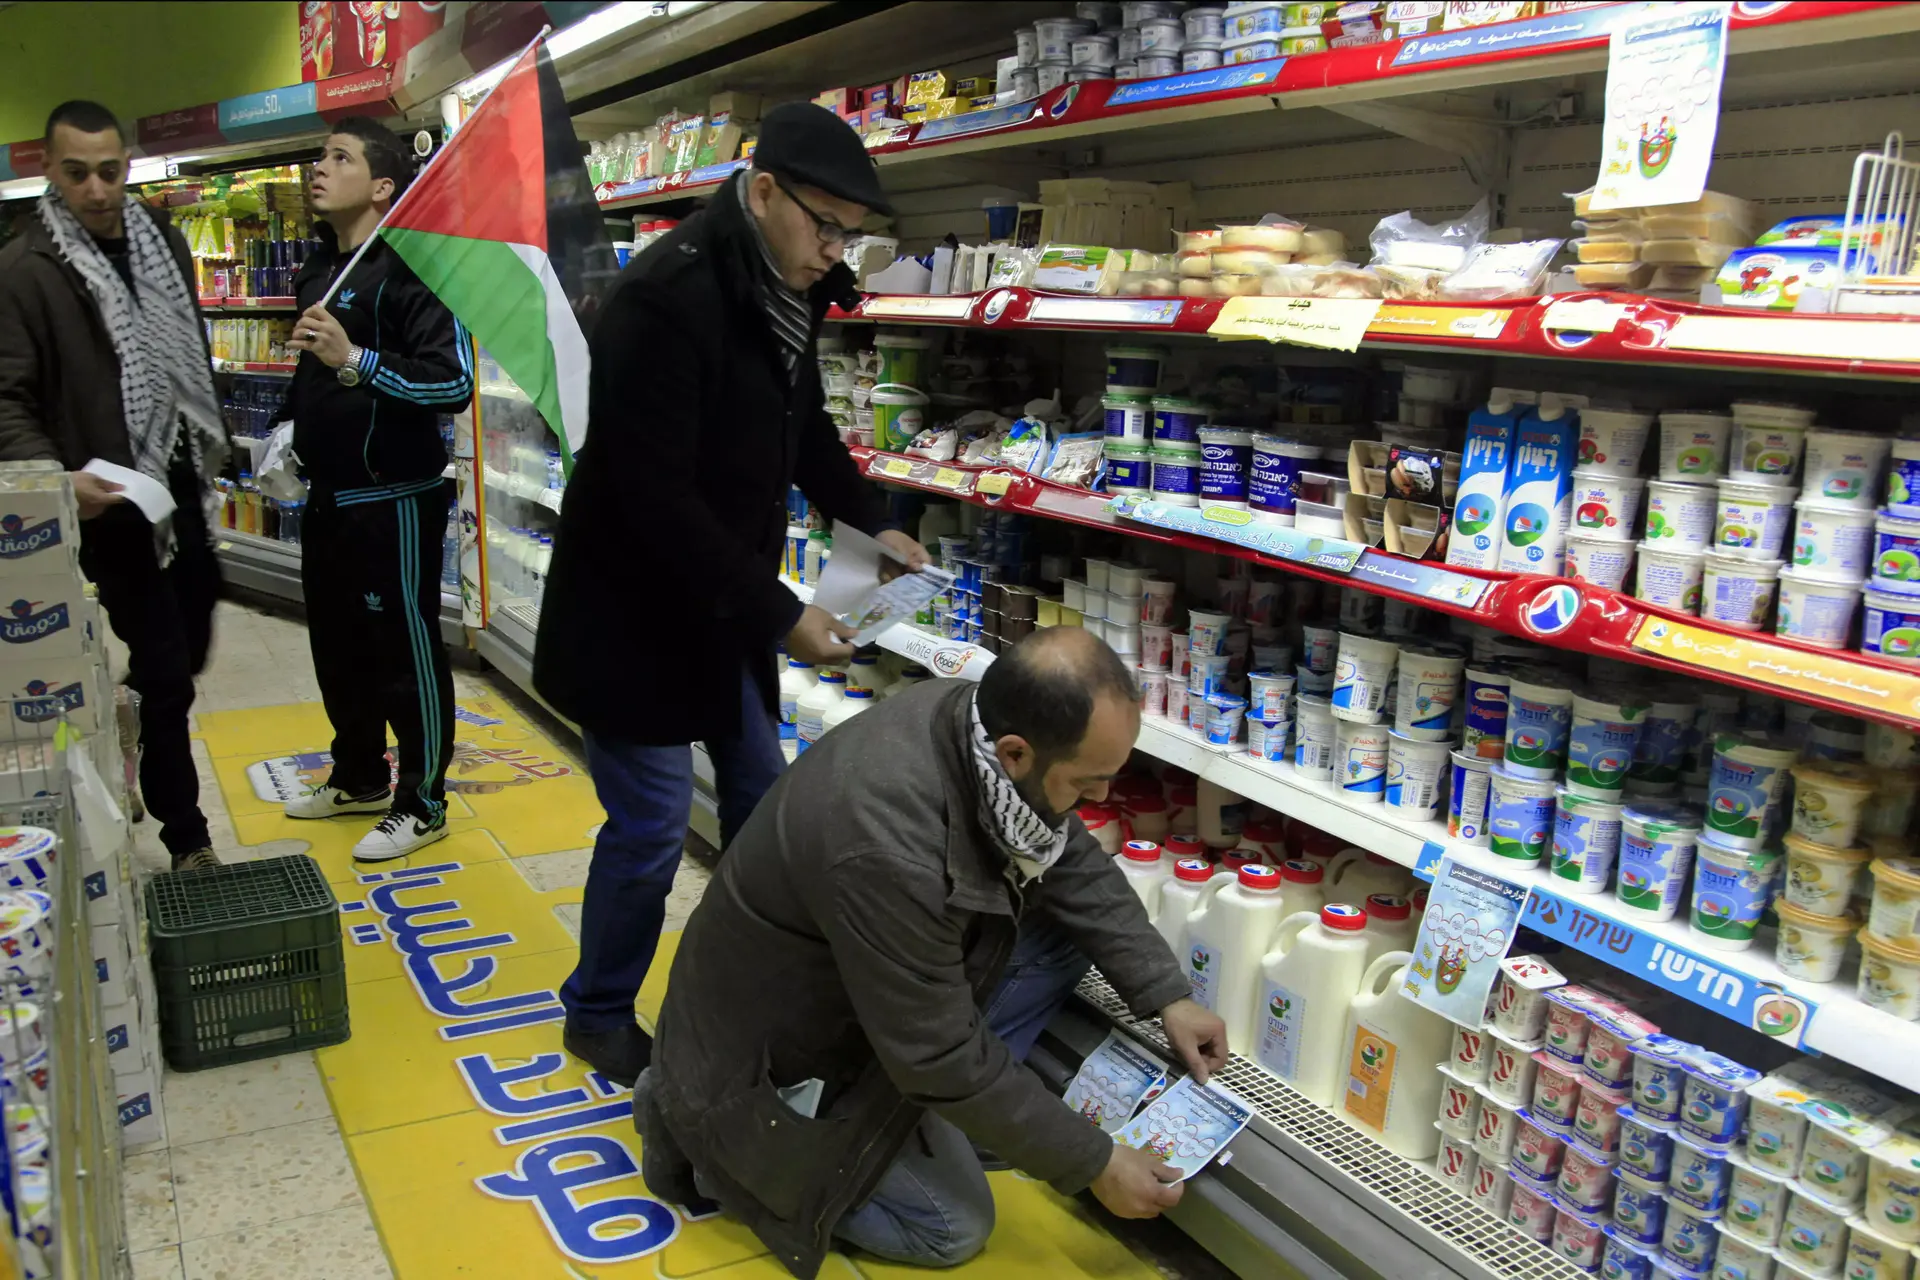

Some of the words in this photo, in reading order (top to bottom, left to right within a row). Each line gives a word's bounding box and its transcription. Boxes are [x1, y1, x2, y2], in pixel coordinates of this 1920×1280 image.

[1258, 470, 1289, 484] לאבנה
[905, 638, 932, 659] white
[20, 693, 78, 718] DOMY
[1451, 866, 1482, 886] الفلسطيني
[1481, 878, 1504, 893] الشعب
[1567, 908, 1635, 955] שוקו
[1646, 942, 1745, 1008] חדש!
[1267, 1016, 1289, 1032] יוגורט
